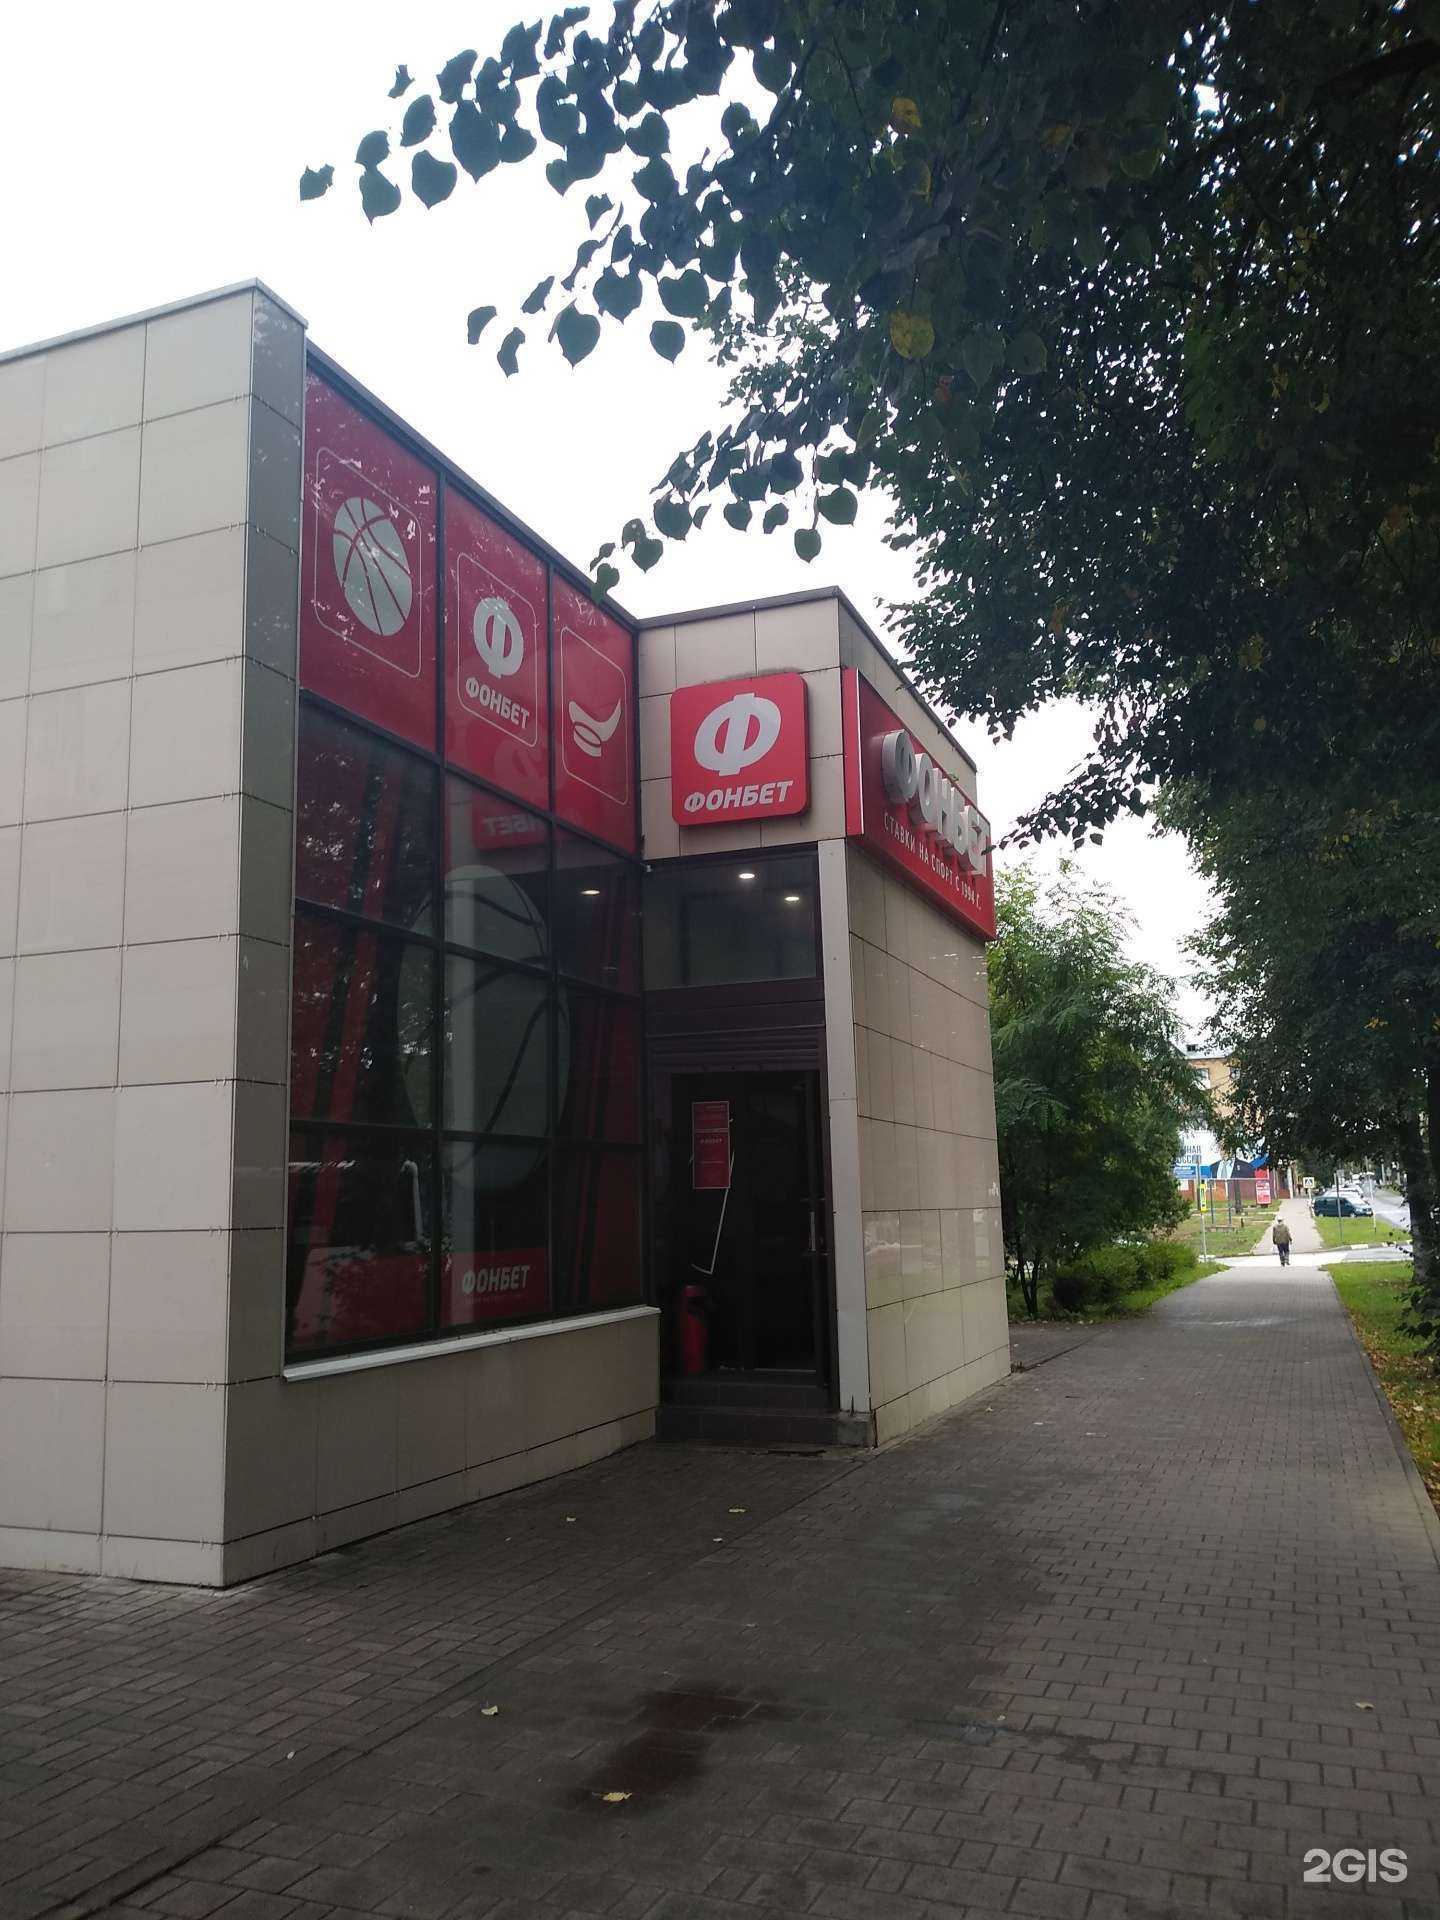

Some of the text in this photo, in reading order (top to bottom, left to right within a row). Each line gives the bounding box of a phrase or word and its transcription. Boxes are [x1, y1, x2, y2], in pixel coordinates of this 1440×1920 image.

[465, 677, 530, 729] ФОНБЕТ
[694, 692, 781, 777] Ф
[683, 780, 794, 813] ФОНБЕТ
[884, 812, 916, 853] СТАВКИ
[919, 842, 929, 864] НА
[931, 854, 953, 885] СПОРТ
[462, 1265, 530, 1295] ФОНБЕТ
